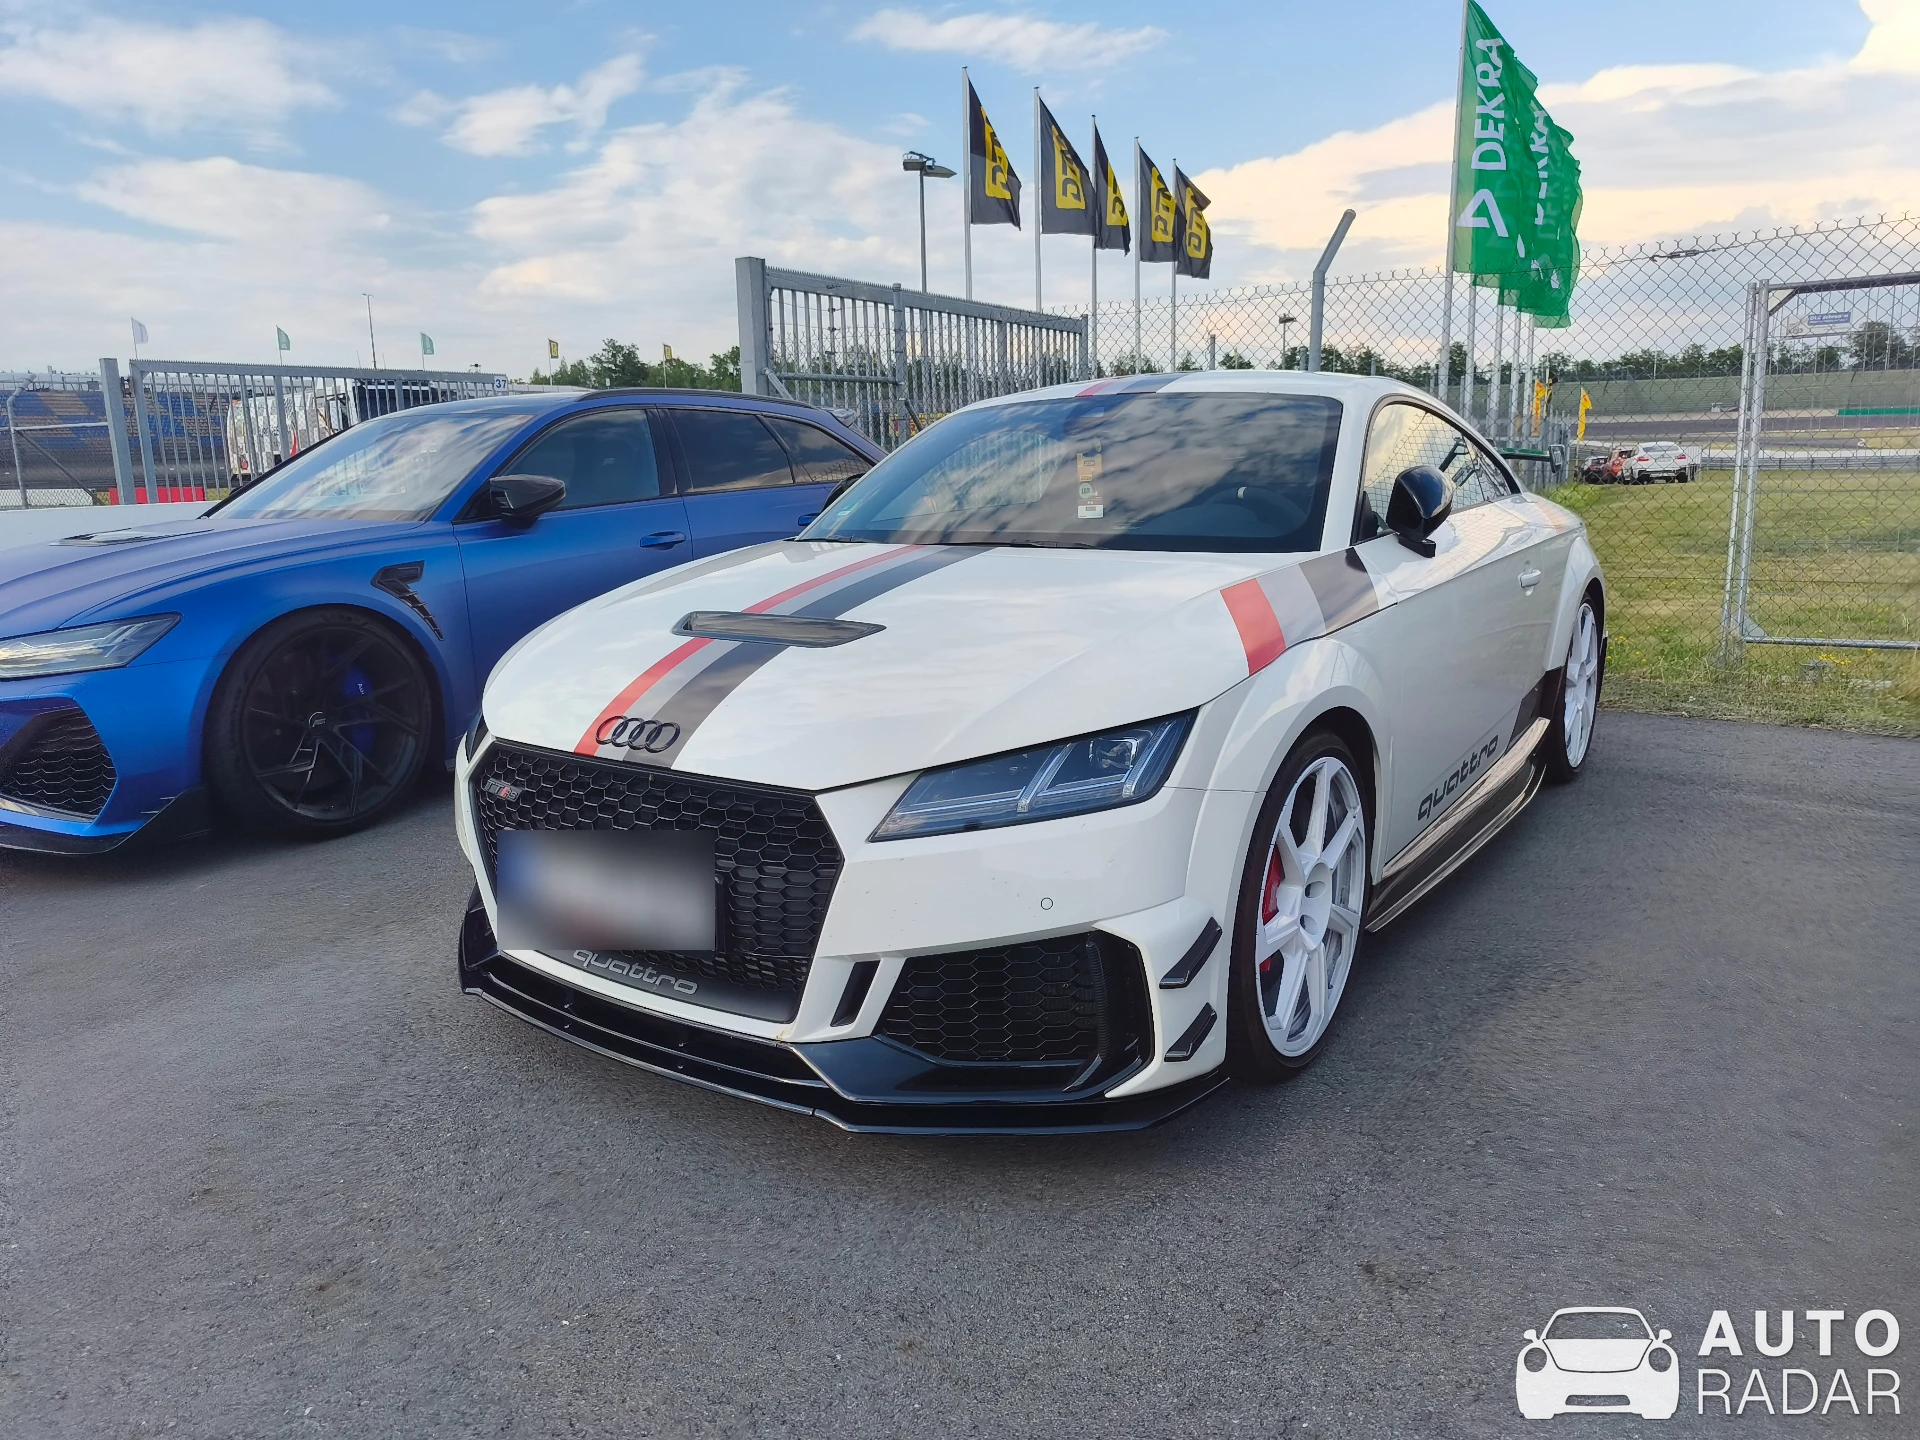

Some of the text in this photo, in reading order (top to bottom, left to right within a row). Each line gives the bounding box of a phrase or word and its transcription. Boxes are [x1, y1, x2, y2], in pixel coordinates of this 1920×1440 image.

[1471, 38, 1505, 170] DEKRA
[495, 379, 506, 388] 37
[1418, 734, 1498, 821] quattro
[572, 949, 698, 995] quattro
